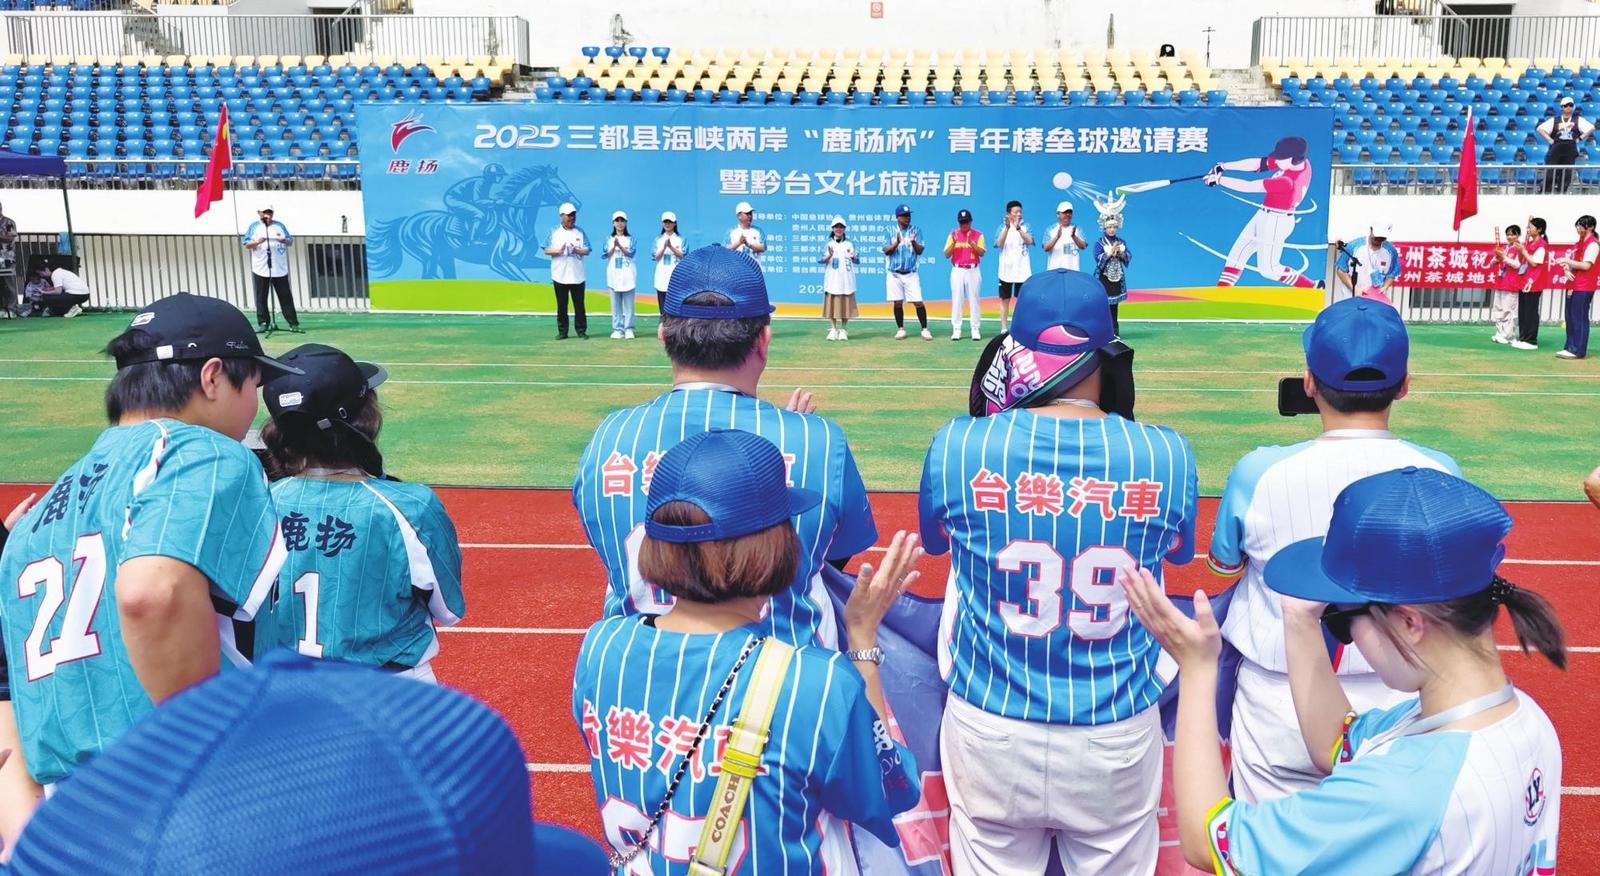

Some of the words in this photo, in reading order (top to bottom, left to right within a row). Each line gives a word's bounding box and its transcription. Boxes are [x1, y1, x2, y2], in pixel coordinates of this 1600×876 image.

[386, 159, 438, 173] 鹿扬
[719, 169, 972, 197] 暨黔台文化旅游周
[1395, 246, 1491, 269] 州茶城祝
[799, 284, 825, 294] 202
[1394, 271, 1496, 284] 州茶城地
[970, 468, 1163, 522] 台樂汽車
[281, 511, 357, 558] 鹿扬
[996, 539, 1139, 641] 39
[292, 571, 324, 658] 1
[711, 774, 741, 843] COACH
